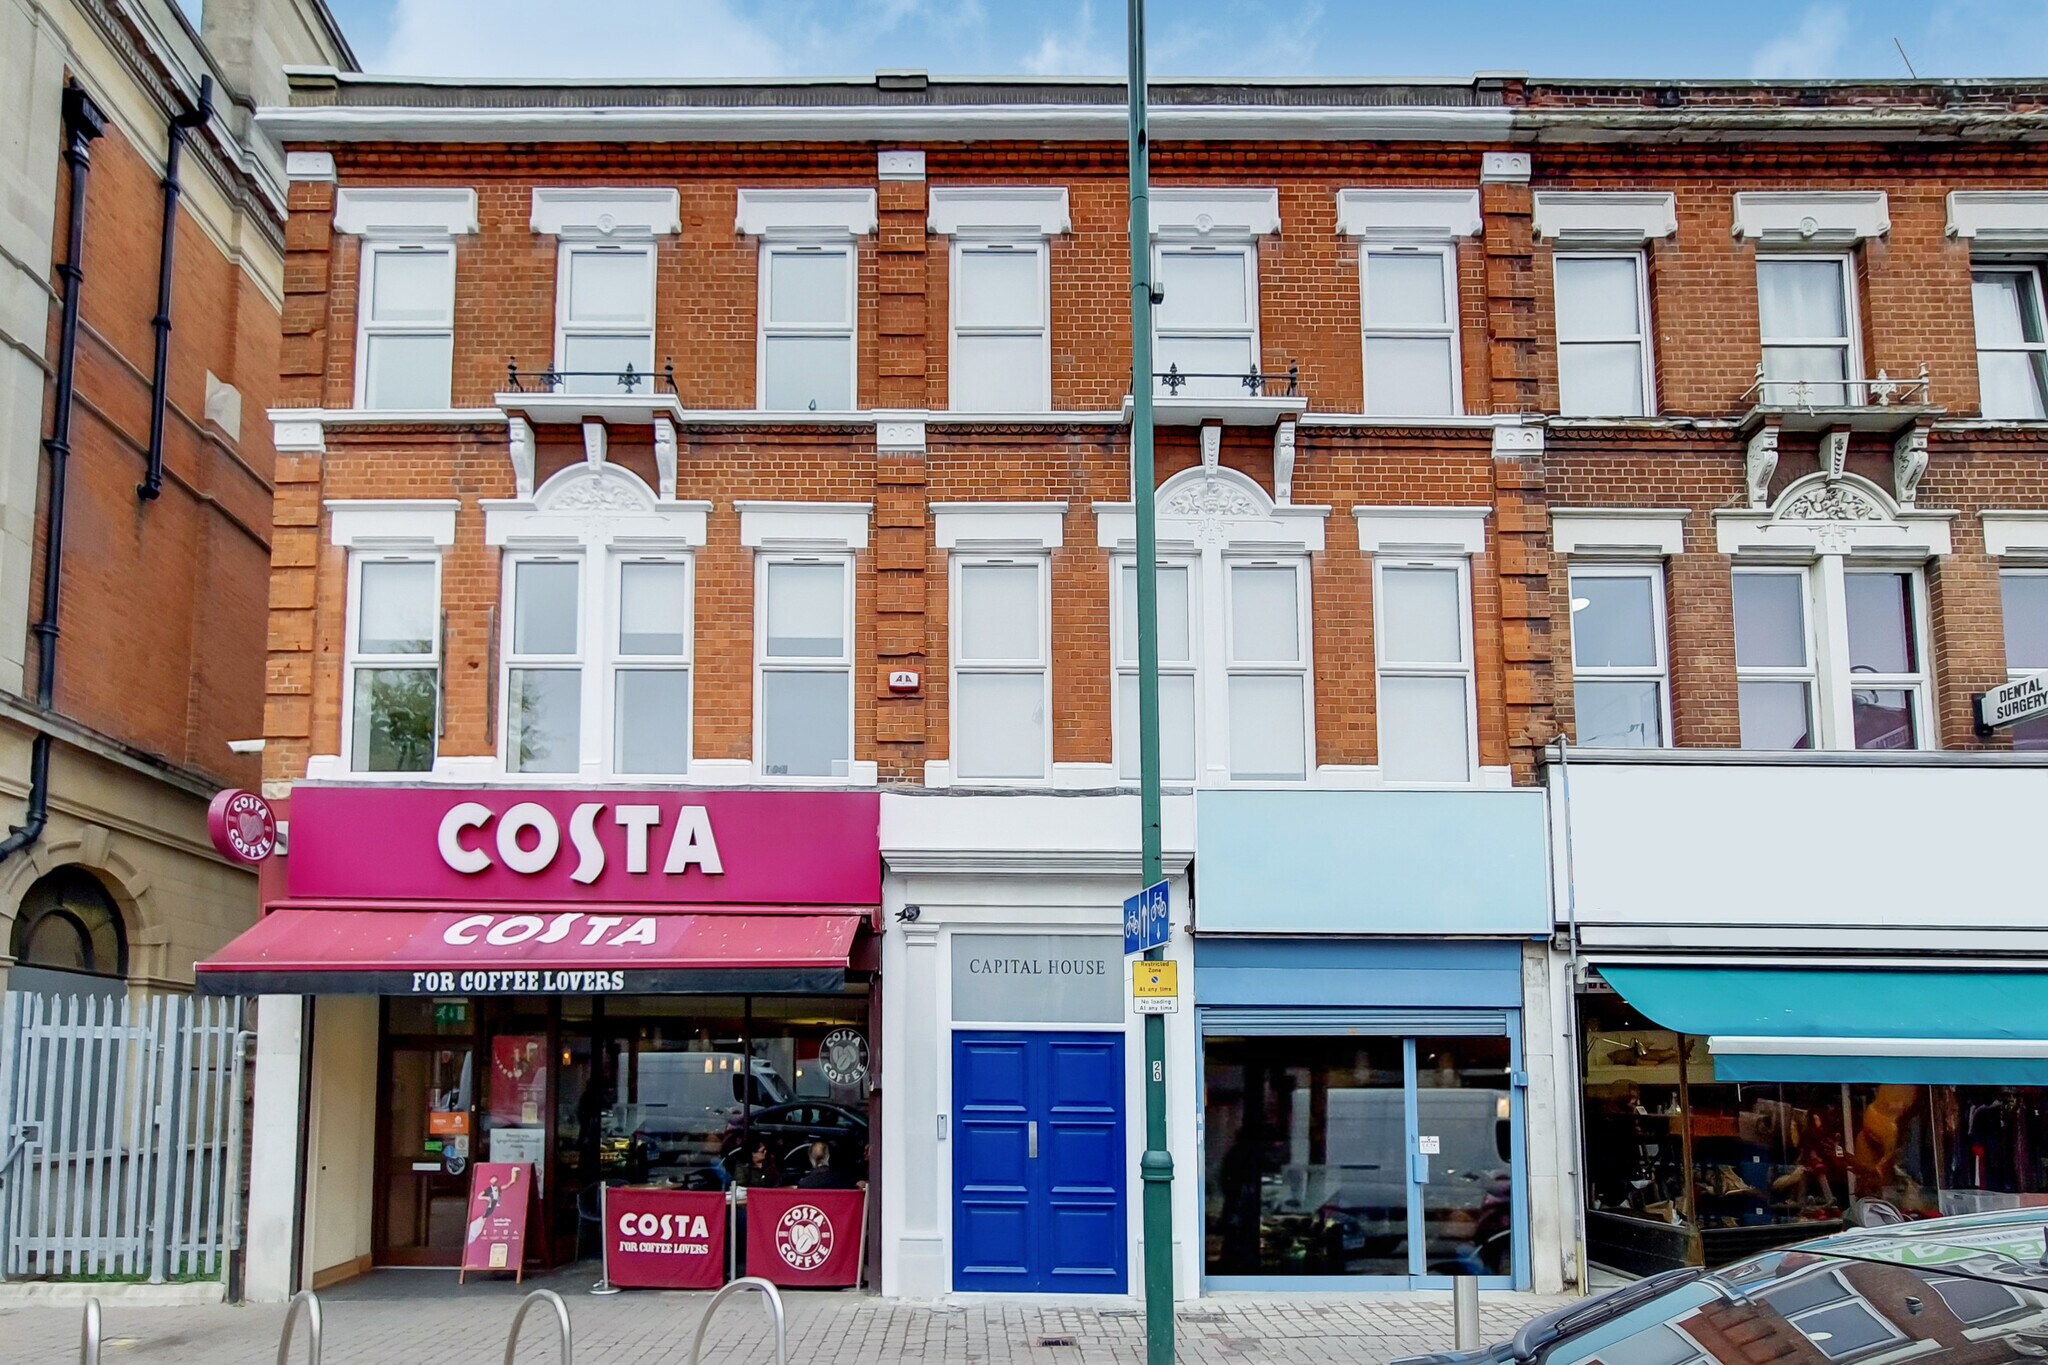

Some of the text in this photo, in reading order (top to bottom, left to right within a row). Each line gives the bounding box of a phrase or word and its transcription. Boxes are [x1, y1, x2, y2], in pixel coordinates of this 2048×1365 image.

[2000, 678, 2043, 703] DENTAL
[1996, 691, 2048, 720] SURGERY
[234, 796, 268, 820] COSTA
[230, 828, 270, 858] COFFEE
[438, 802, 724, 884] COSTA
[443, 912, 658, 946] COSTA
[970, 958, 1106, 975] CAPITAL HOUSE
[412, 971, 625, 992] FOR COFFEE LOVERS
[826, 1030, 860, 1047] COSTA
[823, 1062, 866, 1083] COFFEE
[1154, 1061, 1161, 1080] 20
[619, 1212, 709, 1240] COSTA
[784, 1208, 824, 1227] COSTA
[619, 1241, 708, 1254] FOR COFFEE LOVERS
[780, 1243, 829, 1267] COFFEE
